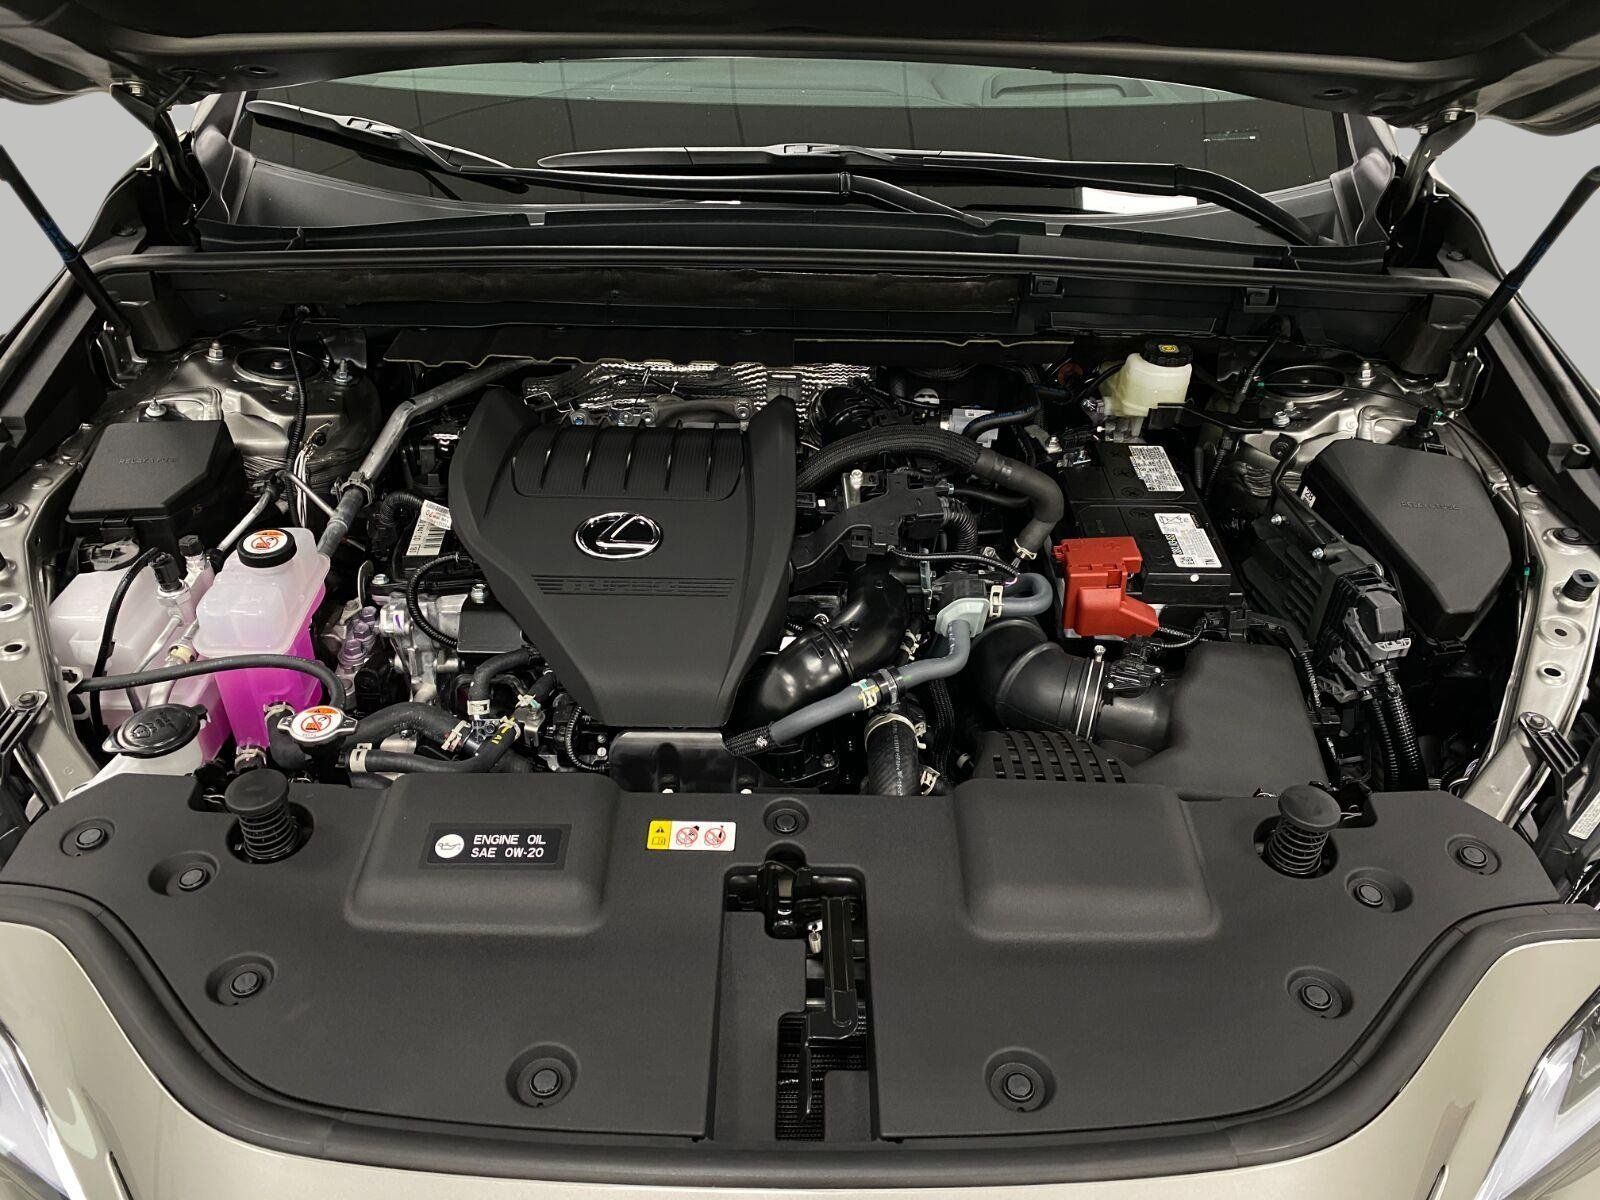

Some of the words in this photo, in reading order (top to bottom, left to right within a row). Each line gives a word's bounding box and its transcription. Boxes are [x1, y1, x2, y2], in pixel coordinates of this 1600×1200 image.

[473, 834, 519, 844] ENGINE
[527, 834, 546, 844] OIL
[471, 847, 497, 857] SAE
[504, 847, 544, 857] 0W-20
